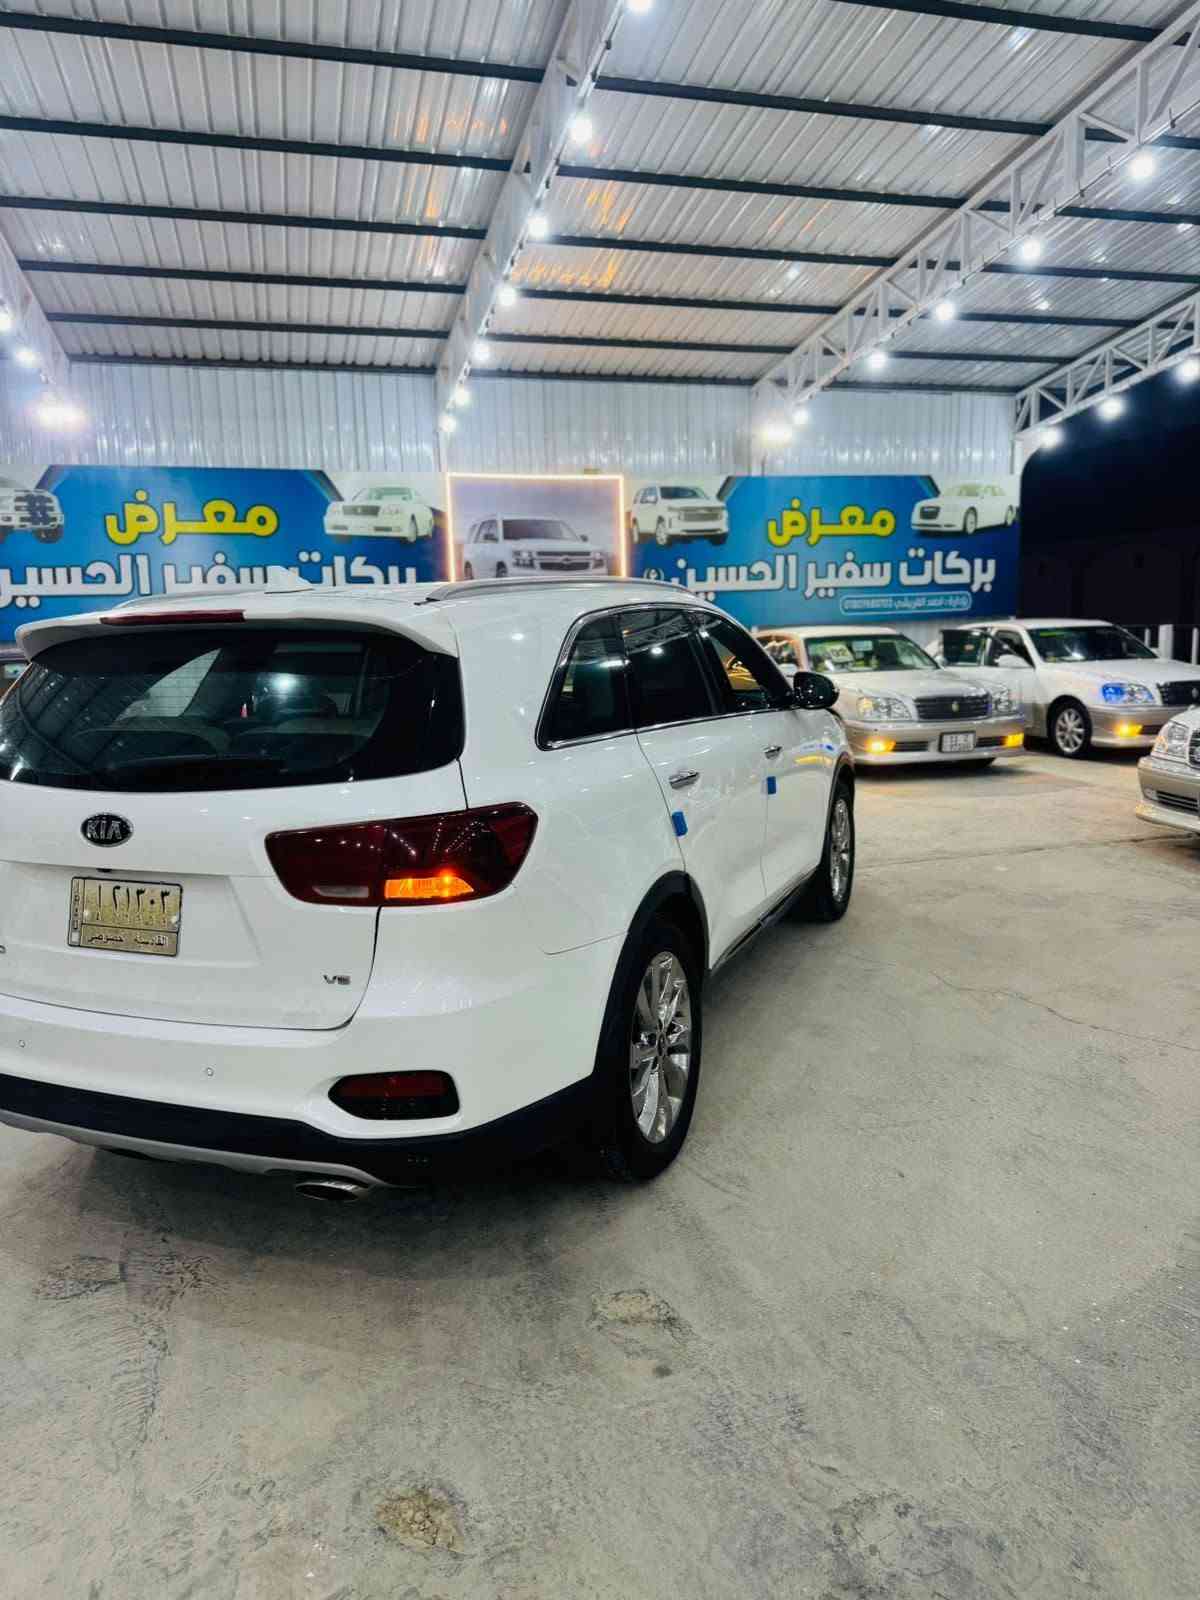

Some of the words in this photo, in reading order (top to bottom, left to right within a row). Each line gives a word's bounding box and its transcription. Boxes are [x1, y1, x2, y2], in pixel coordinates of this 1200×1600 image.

[105, 489, 279, 545] معرض
[768, 498, 896, 546] معرض
[804, 551, 892, 598] سفير
[899, 546, 996, 593] بركات
[87, 819, 122, 840] KIA
